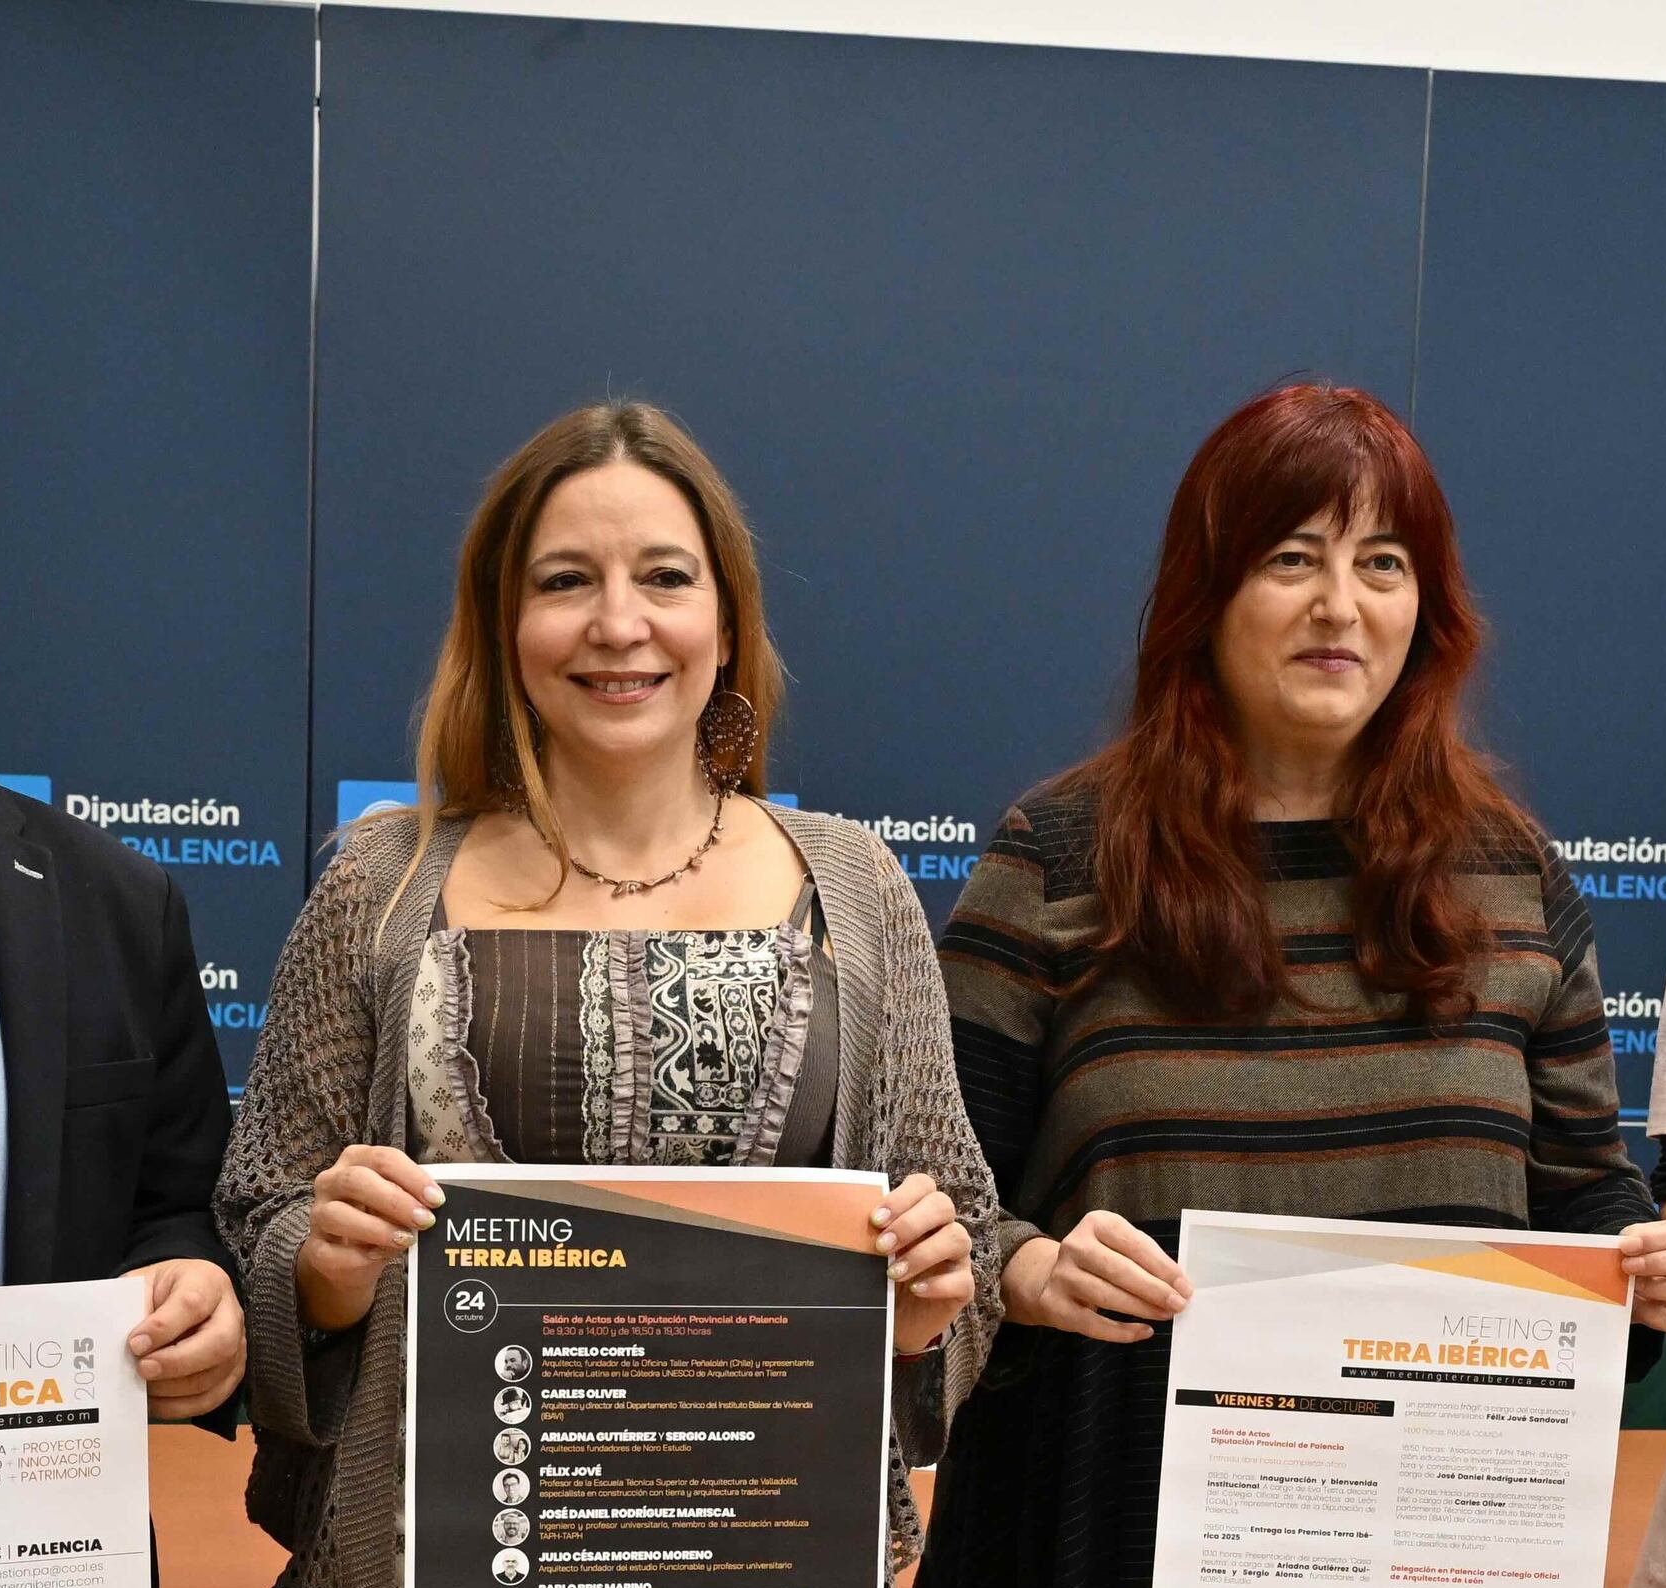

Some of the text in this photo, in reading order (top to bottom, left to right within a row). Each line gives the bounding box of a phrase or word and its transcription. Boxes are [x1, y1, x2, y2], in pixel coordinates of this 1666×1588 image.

[66, 794, 240, 828] Diputación
[447, 1218, 572, 1242] MEETING
[445, 1243, 626, 1267] TERRA IBÉRICA
[456, 1291, 485, 1310] 24
[543, 1315, 569, 1323] Salón
[571, 1315, 583, 1323] de
[585, 1315, 612, 1324] Actos
[627, 1315, 636, 1323] la
[638, 1315, 687, 1325] Diputación
[689, 1315, 733, 1323] Provincial
[735, 1316, 747, 1324] de
[749, 1315, 788, 1324] Palencia
[1442, 1315, 1552, 1341] MEETING
[542, 1344, 645, 1356] MARCELO CORTÉS
[1343, 1339, 1549, 1369] TERRA IBÉRICA
[1557, 1322, 1577, 1372] 2025
[74, 1338, 94, 1399] 2025
[541, 1389, 626, 1399] CARLES OLIVER
[1215, 1393, 1380, 1414] VIERNES 24 DE OCTUBRE
[540, 1429, 755, 1442] ARIADNA GUTIÉRREZ Y SERGIO ALONSO
[23, 1438, 100, 1454] PROYECTOS
[18, 1451, 100, 1468] INNOVACIÓN
[21, 1466, 101, 1482] PATRIMONIO
[540, 1464, 602, 1476] FÉLIX JOVÉ
[539, 1505, 736, 1519] JOSÉ DANIEL RODRÍGUEZ MARISCAL
[18, 1539, 102, 1557] PALENCIA
[539, 1549, 713, 1562] JULIO CÉSAR MORENO MORENO
